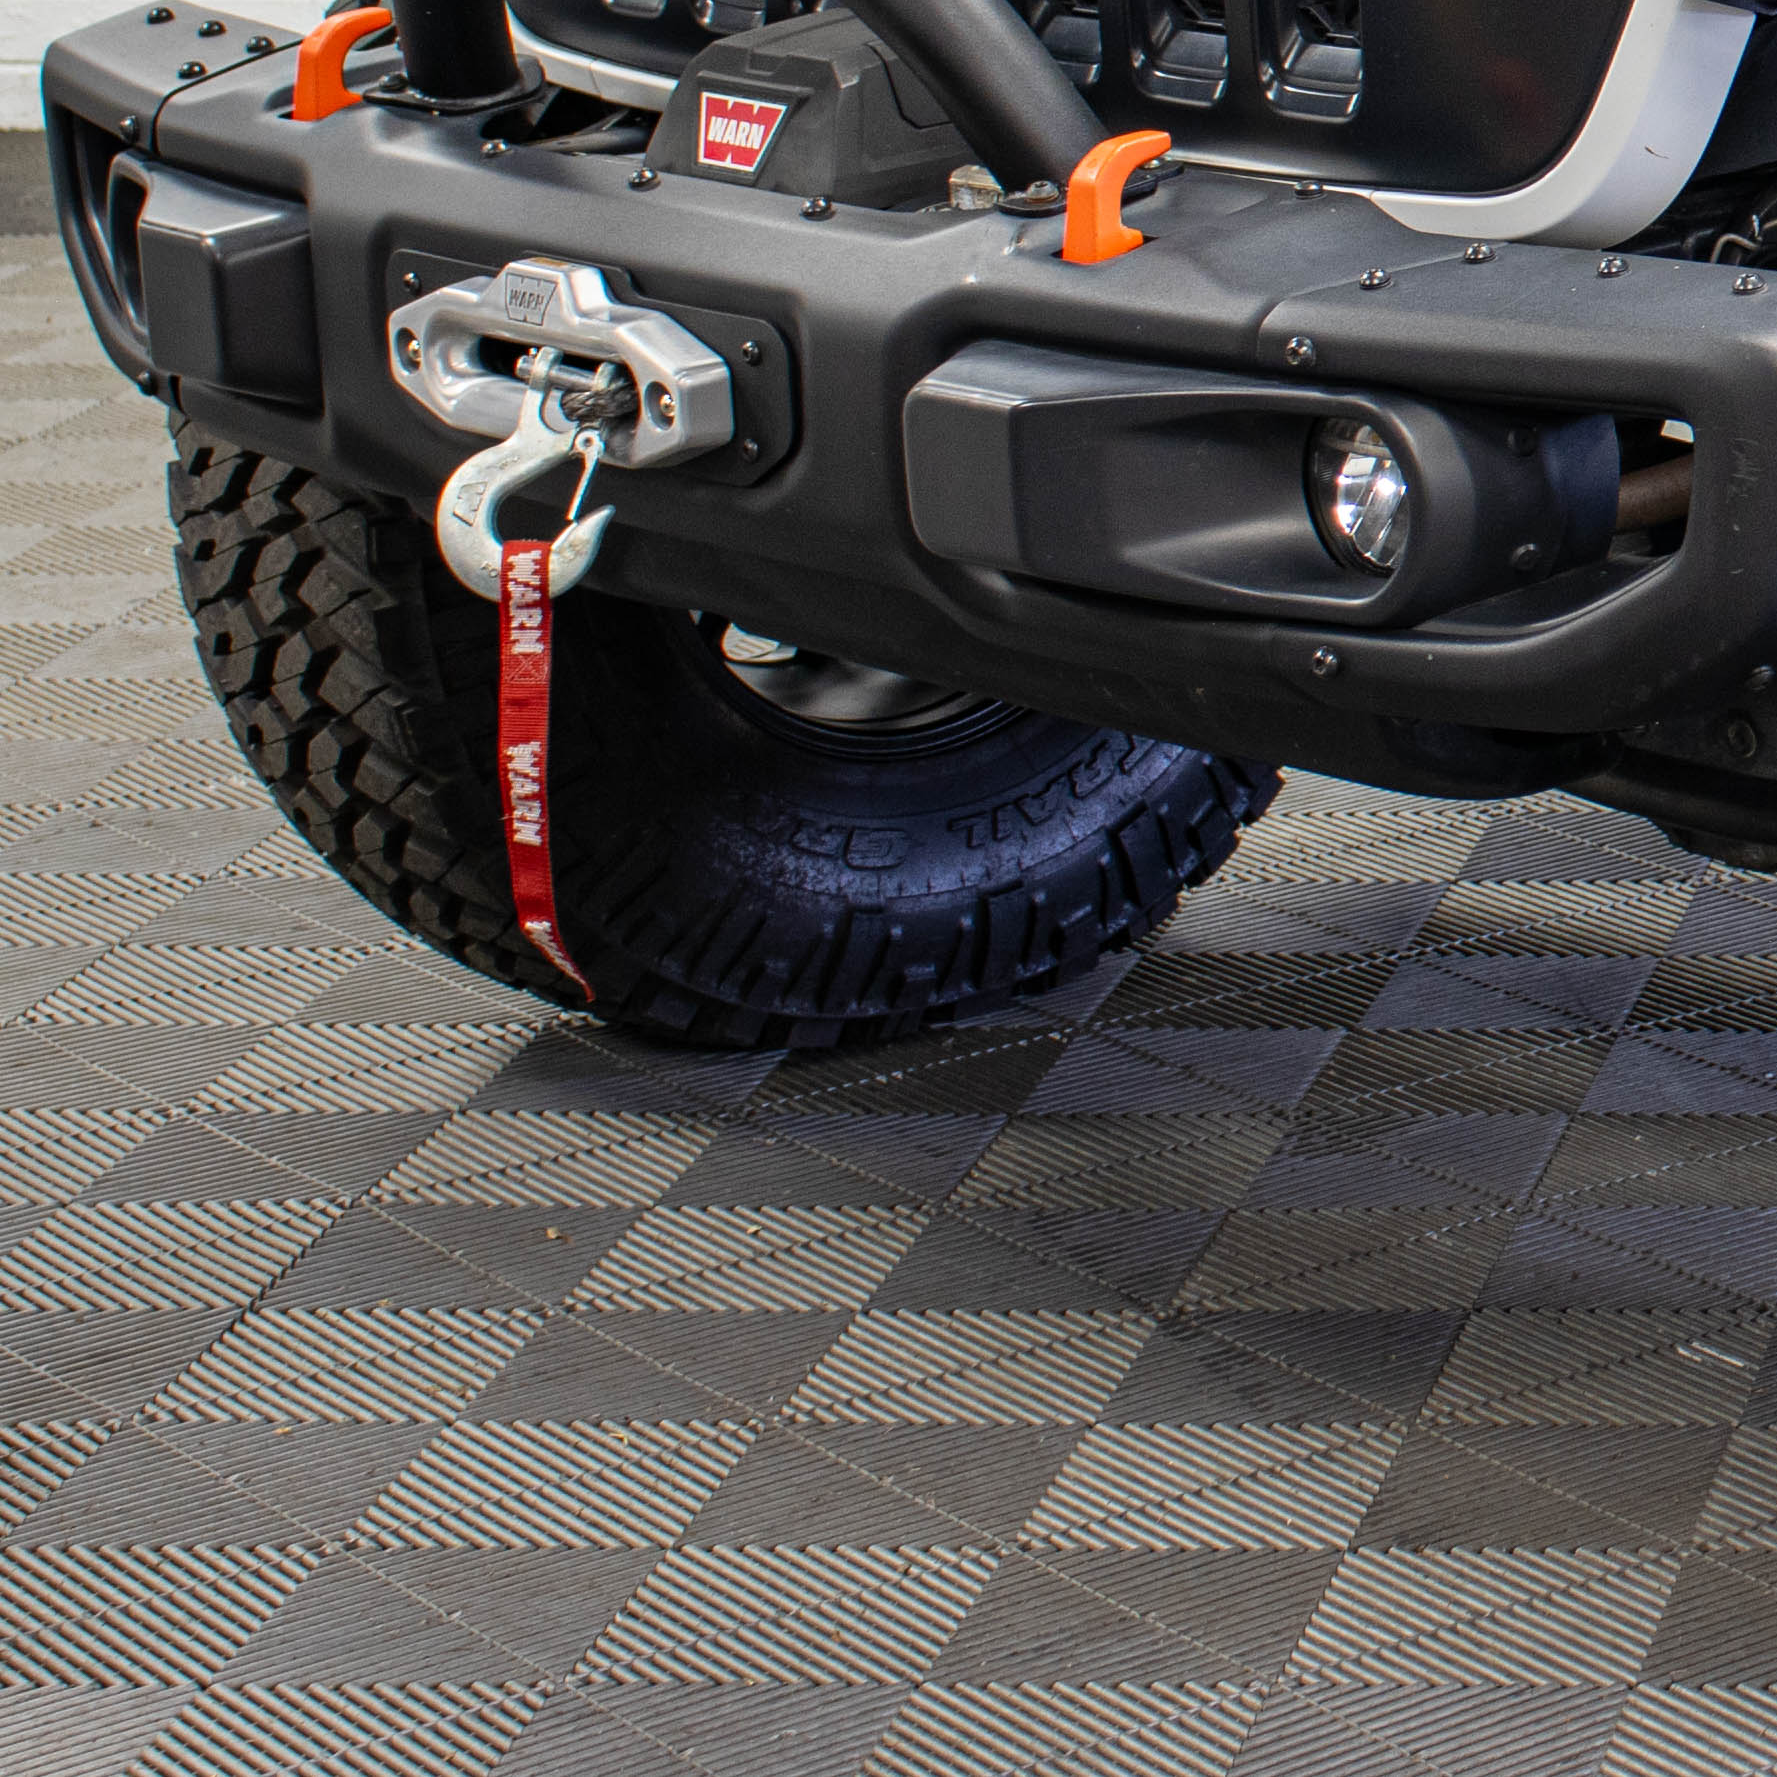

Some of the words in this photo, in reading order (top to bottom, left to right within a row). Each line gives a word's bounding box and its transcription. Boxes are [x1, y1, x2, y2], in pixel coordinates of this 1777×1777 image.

[706, 115, 766, 150] WARN
[508, 288, 545, 312] WARN
[505, 548, 544, 654] WARN
[505, 740, 543, 847] WARN
